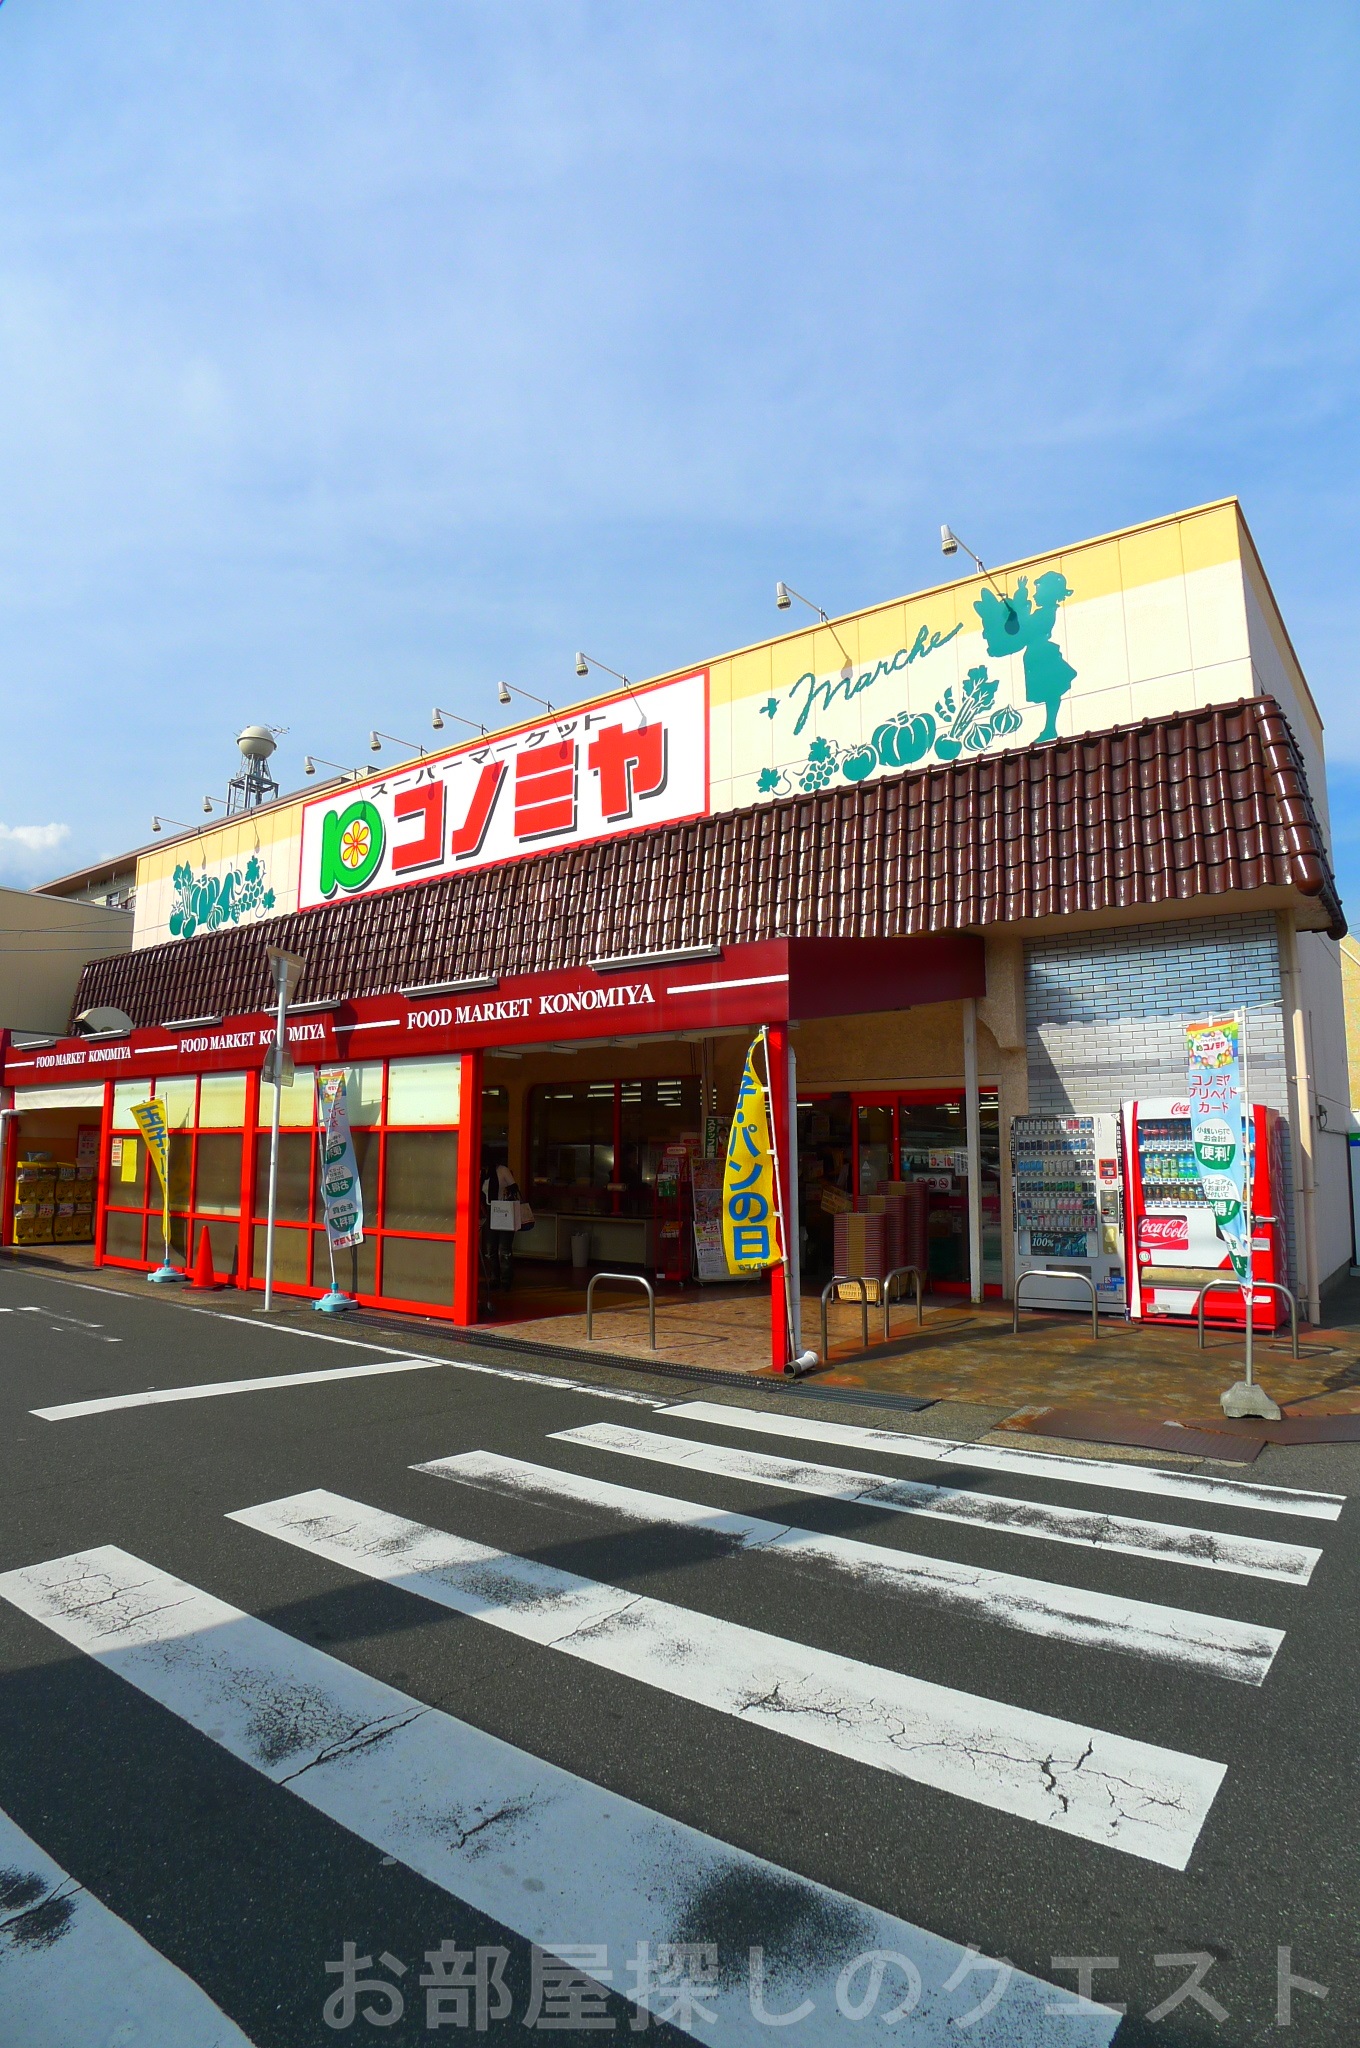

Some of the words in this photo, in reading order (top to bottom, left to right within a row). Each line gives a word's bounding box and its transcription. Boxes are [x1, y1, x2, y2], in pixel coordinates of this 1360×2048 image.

[370, 714, 607, 799] スーパーマーケット
[392, 723, 668, 877] コノミヤ
[407, 1008, 452, 1030] FOOD
[455, 998, 532, 1024] MARKET
[538, 983, 656, 1015] KONOMIYA
[180, 1036, 209, 1053] FOOD
[209, 1032, 254, 1050] MARKET
[258, 1023, 325, 1045] KOMIYA
[36, 1056, 55, 1068] FOOD
[55, 1051, 86, 1066] MARKET
[88, 1046, 131, 1063] KONOMIYA
[1192, 1074, 1230, 1087] コノミヤ
[1199, 1101, 1229, 1114] カード
[1200, 1145, 1231, 1162] 便利!
[1032, 1238, 1055, 1247] 100%
